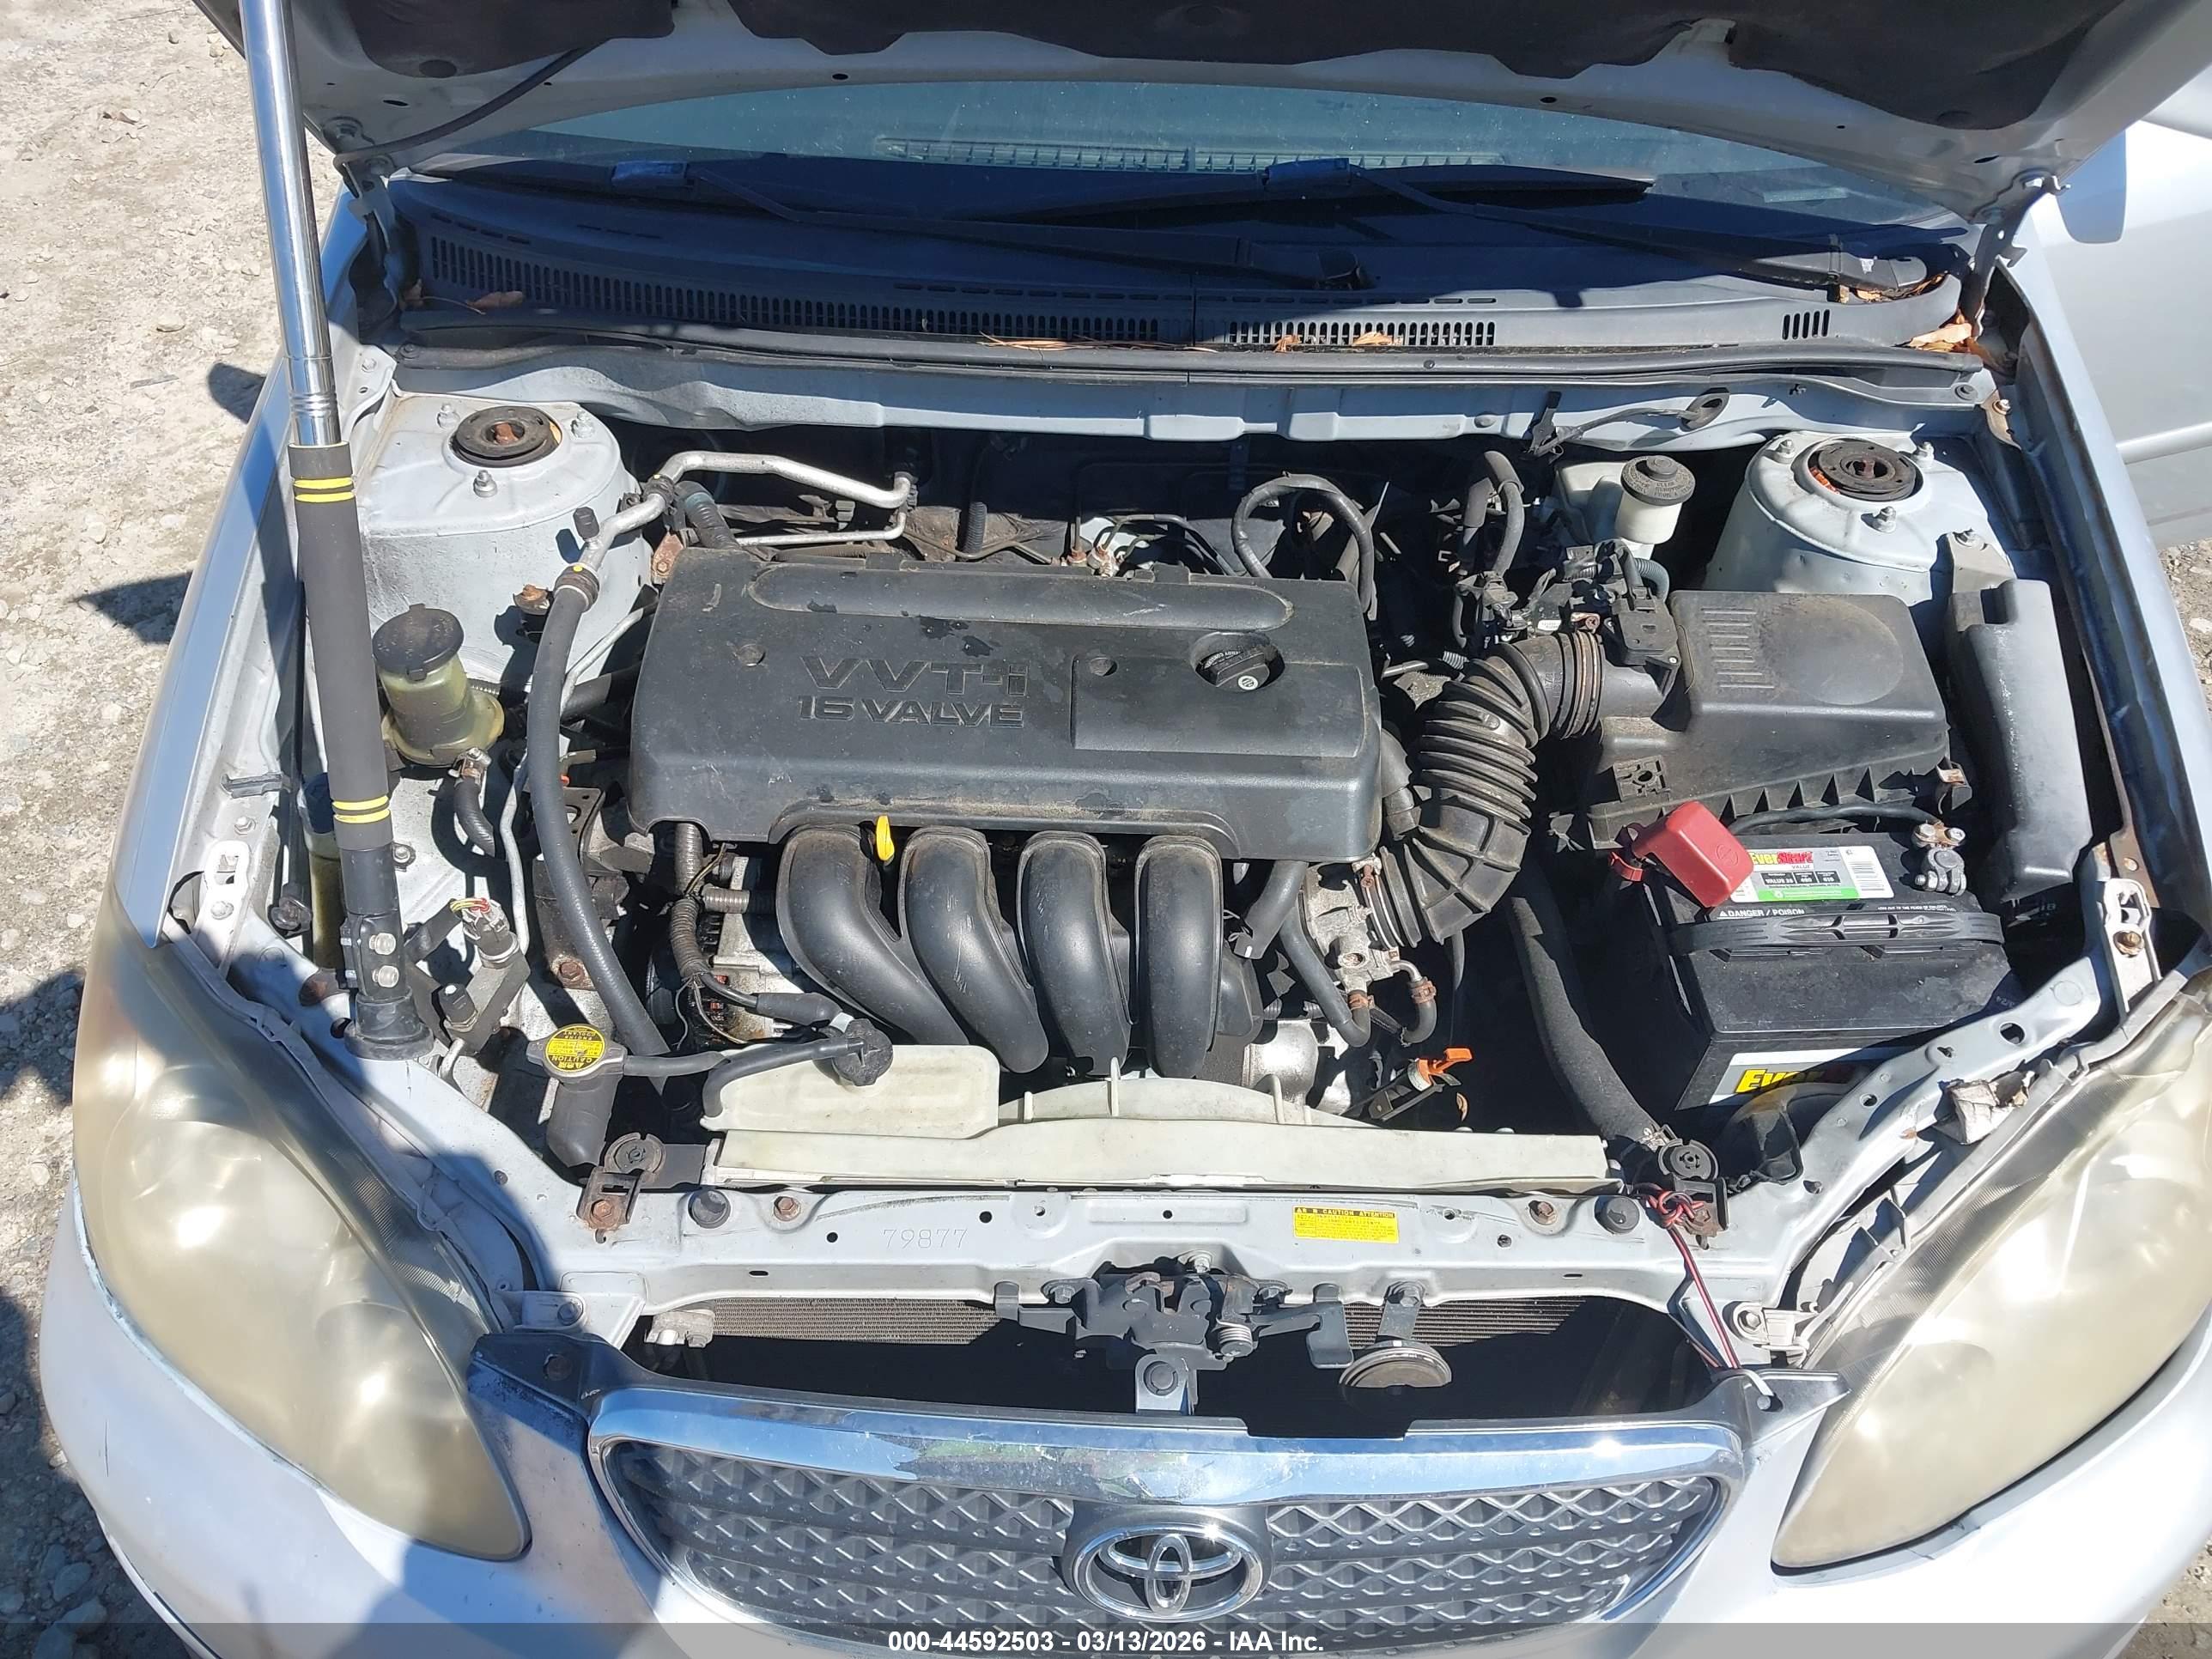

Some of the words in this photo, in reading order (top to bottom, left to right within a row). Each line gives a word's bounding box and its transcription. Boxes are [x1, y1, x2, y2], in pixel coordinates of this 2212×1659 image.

[799, 656, 1029, 696] VVT-i
[799, 696, 855, 721] 16
[861, 699, 1024, 728] VALVE
[882, 1228, 969, 1249] 79877
